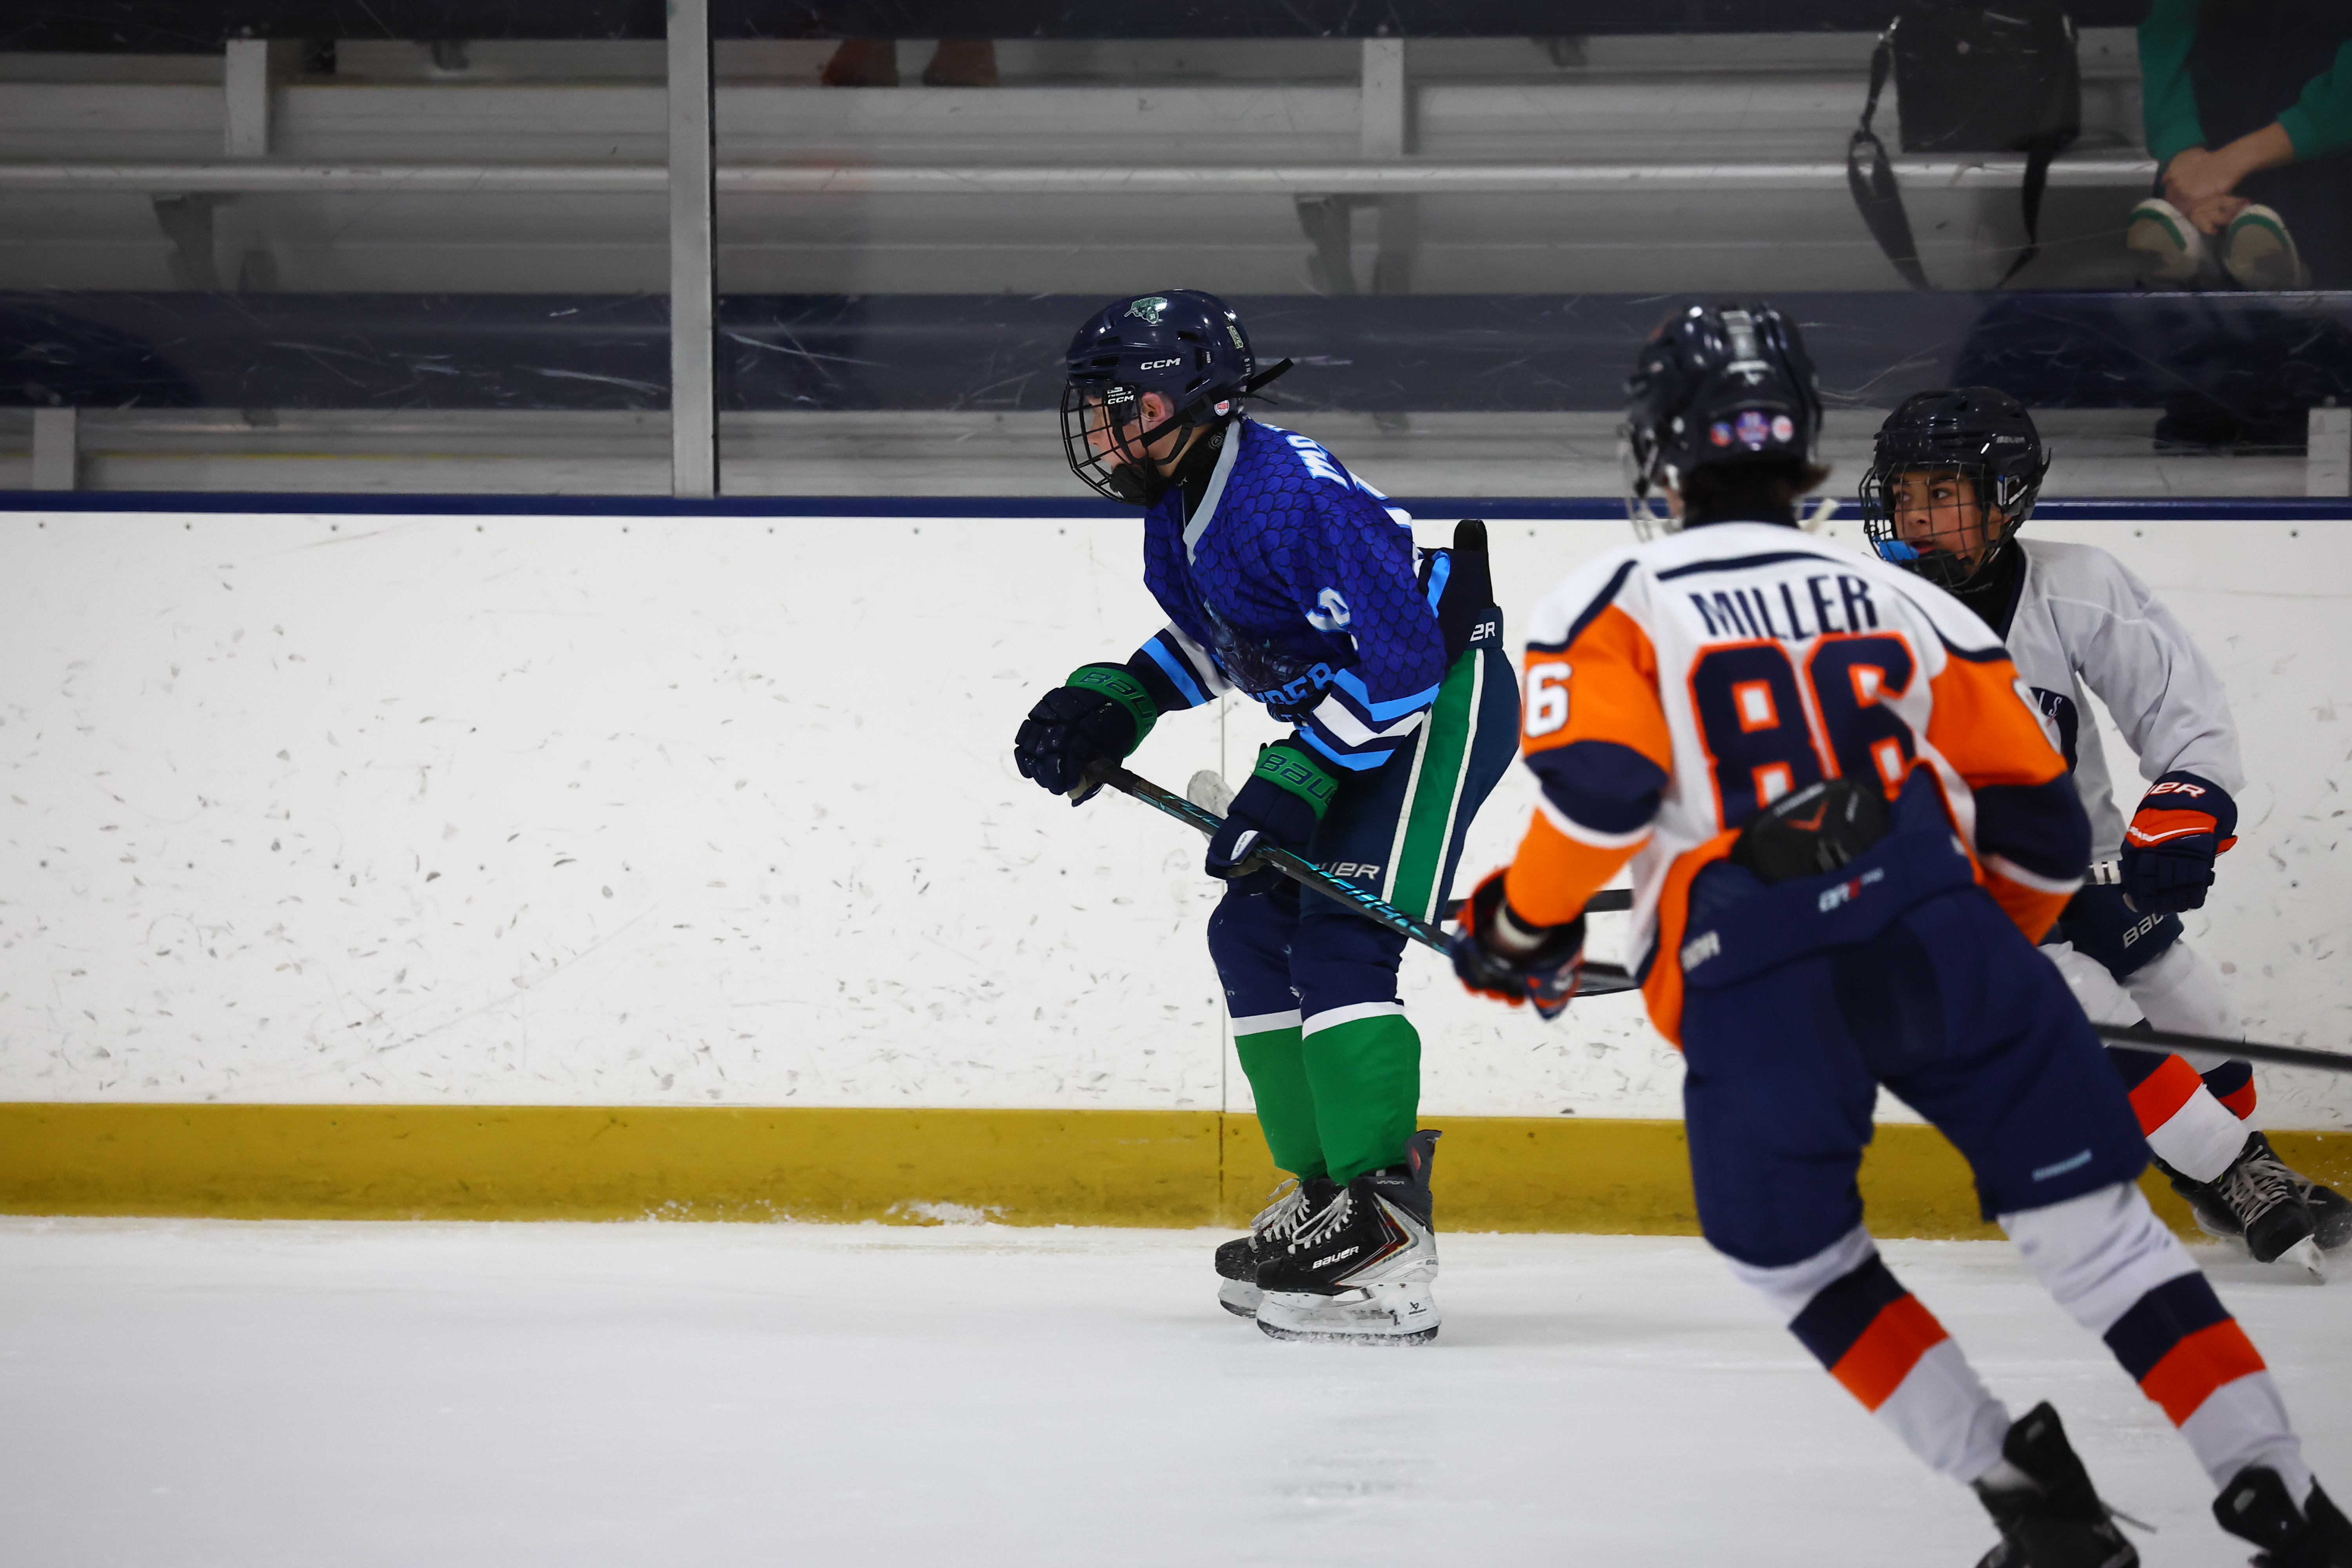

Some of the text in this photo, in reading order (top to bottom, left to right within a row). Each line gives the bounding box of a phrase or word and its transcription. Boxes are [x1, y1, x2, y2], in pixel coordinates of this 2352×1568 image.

[1140, 358, 1181, 370] CCM
[1107, 395, 1134, 405] CCM
[1688, 574, 1878, 641] MILLER
[1526, 661, 1572, 737] 6
[1687, 632, 1916, 831] 86
[1259, 753, 1337, 807] BAU
[2123, 913, 2169, 949] BAU
[1312, 1246, 1359, 1269] BAUER
